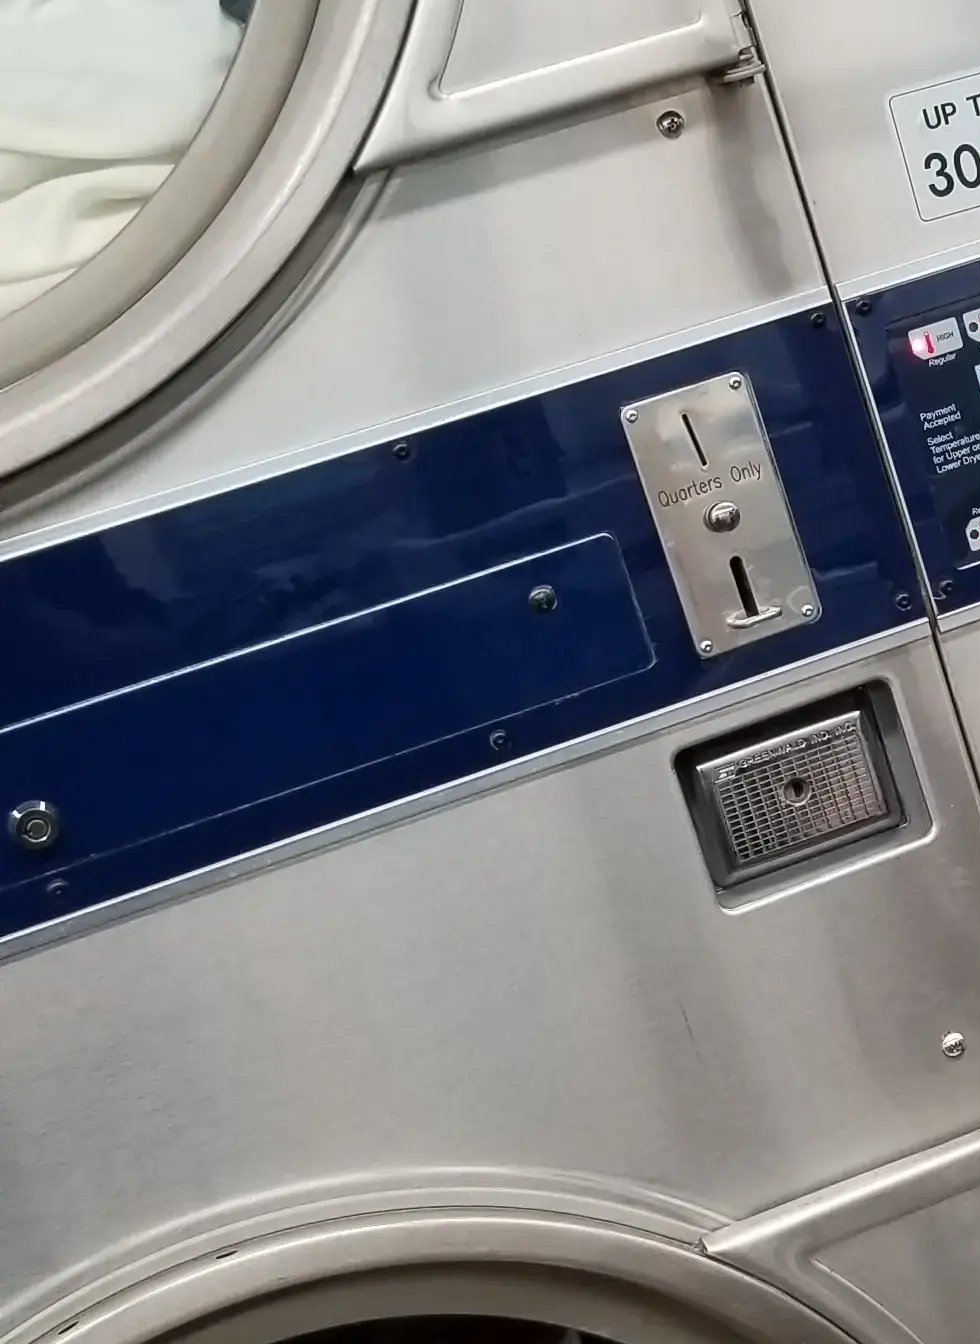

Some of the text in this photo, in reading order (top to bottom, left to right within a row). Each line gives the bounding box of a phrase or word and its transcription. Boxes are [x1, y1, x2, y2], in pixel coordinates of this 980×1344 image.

[922, 102, 957, 130] UP
[936, 330, 954, 342] HIGH
[928, 352, 956, 367] Regular
[919, 403, 958, 421] Payment
[922, 411, 961, 430] Accepted
[926, 431, 953, 446] Select
[929, 433, 980, 454] Temperature
[932, 442, 980, 464] for Upper or
[936, 459, 961, 473] Lower
[658, 460, 762, 507] Quarters Only
